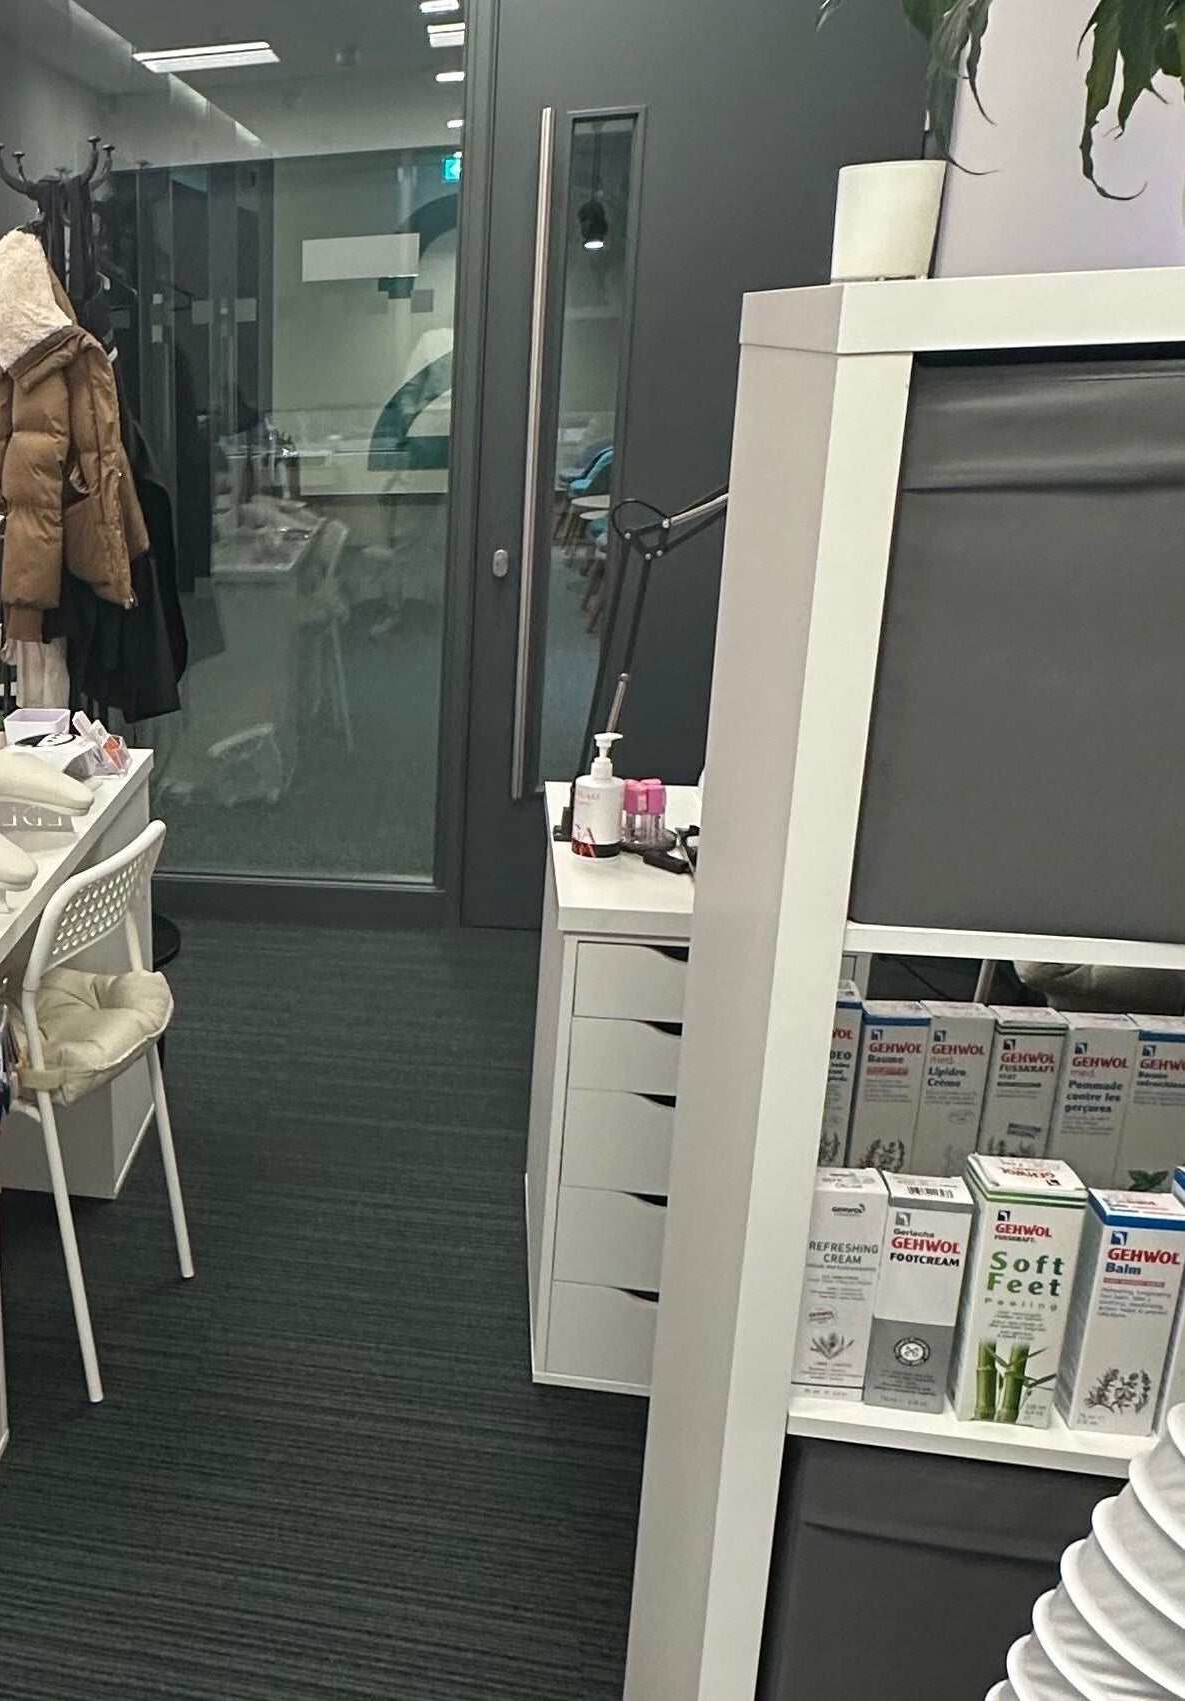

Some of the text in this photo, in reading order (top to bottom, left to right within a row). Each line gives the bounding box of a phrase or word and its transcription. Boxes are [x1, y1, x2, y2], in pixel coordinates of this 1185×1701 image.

[869, 1042, 923, 1054] GEHWOL
[931, 1043, 985, 1056] GEHWOL
[1000, 1051, 1055, 1064] GEHWOL
[1072, 1056, 1129, 1069] GEHWOL
[994, 1222, 1053, 1238] GEHWOL
[808, 1240, 879, 1255] REFRESHING
[891, 1236, 961, 1255] GEHWOL
[822, 1253, 862, 1265] CREAM
[889, 1251, 960, 1268] FOOTCREAM
[989, 1250, 1065, 1276] Soft
[1107, 1247, 1181, 1266] GEHWOL
[1105, 1262, 1142, 1276] Balm
[986, 1271, 1062, 1297] Feet
